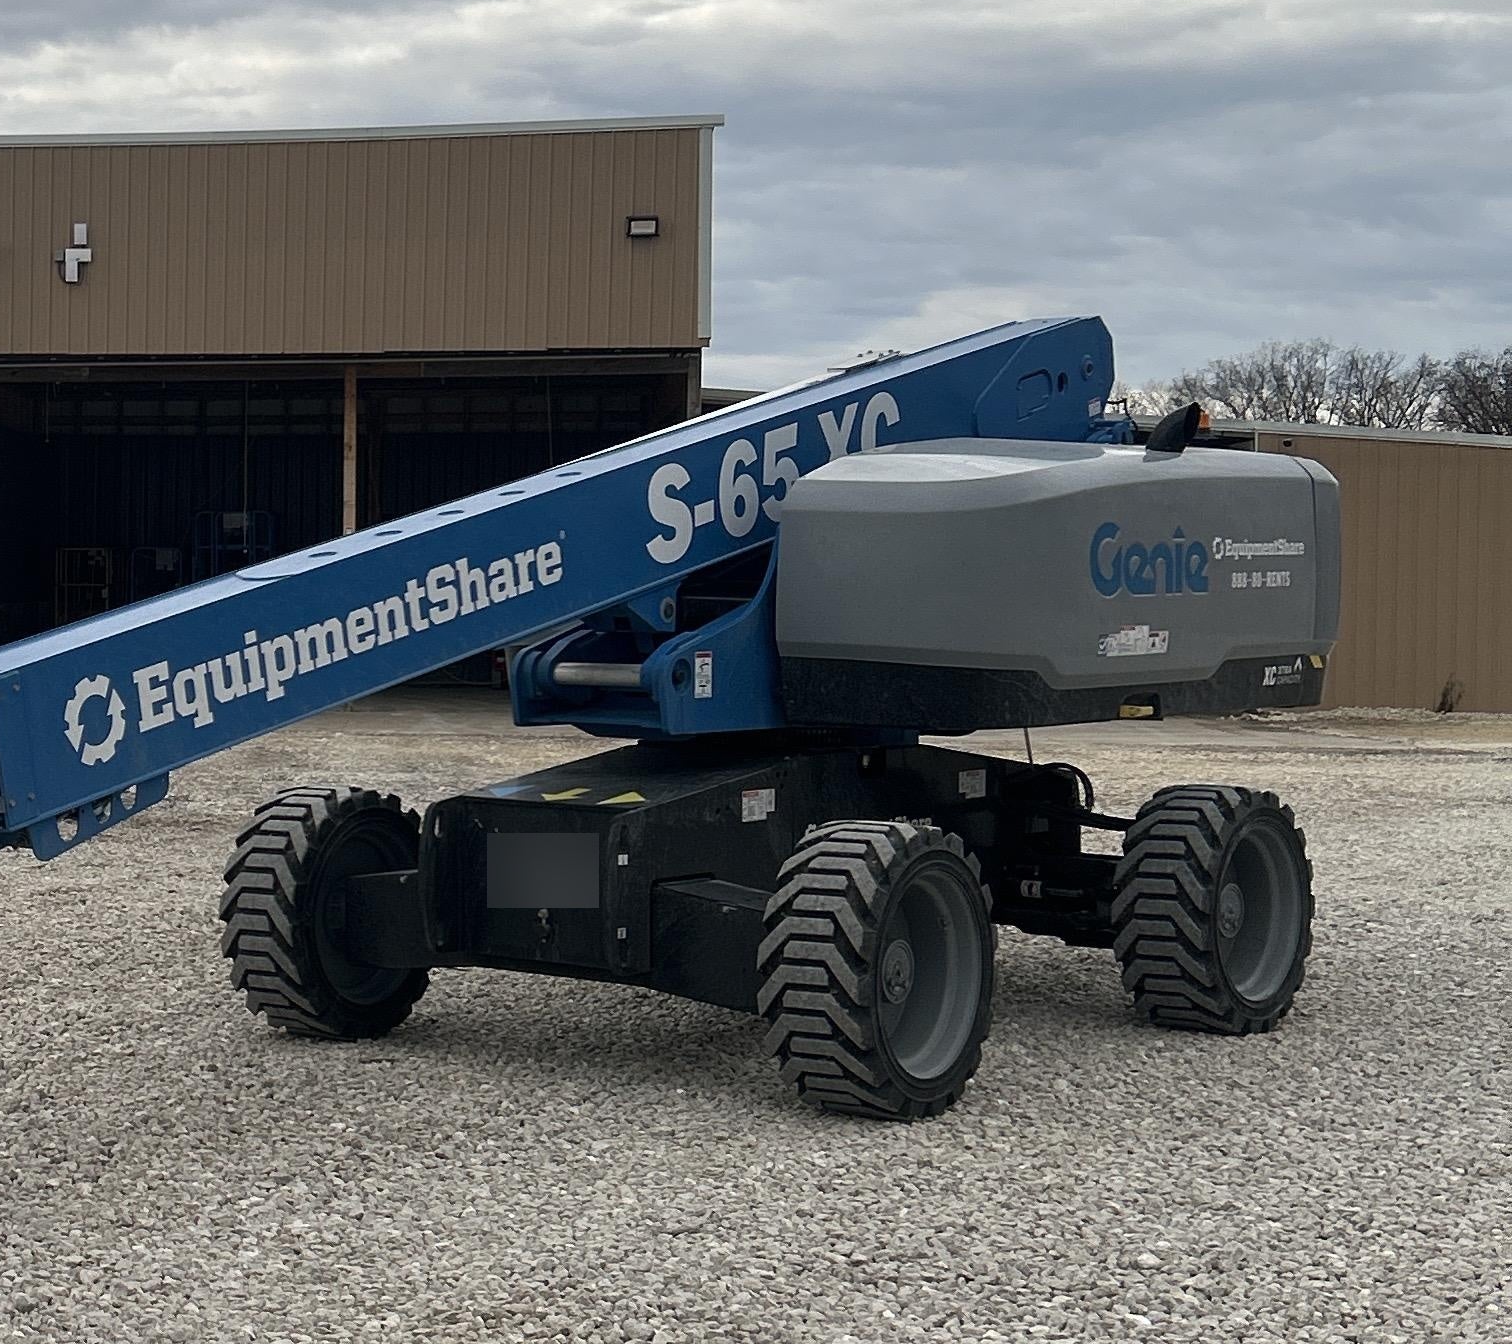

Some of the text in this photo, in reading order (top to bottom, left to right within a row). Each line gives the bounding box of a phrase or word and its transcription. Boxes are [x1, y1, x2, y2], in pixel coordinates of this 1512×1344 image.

[645, 391, 900, 564] S-65 XC
[1090, 522, 1210, 599] Genie
[1225, 538, 1305, 560] EquipmentShare
[132, 540, 565, 733] EquipmentShare
[1262, 665, 1277, 686] XC
